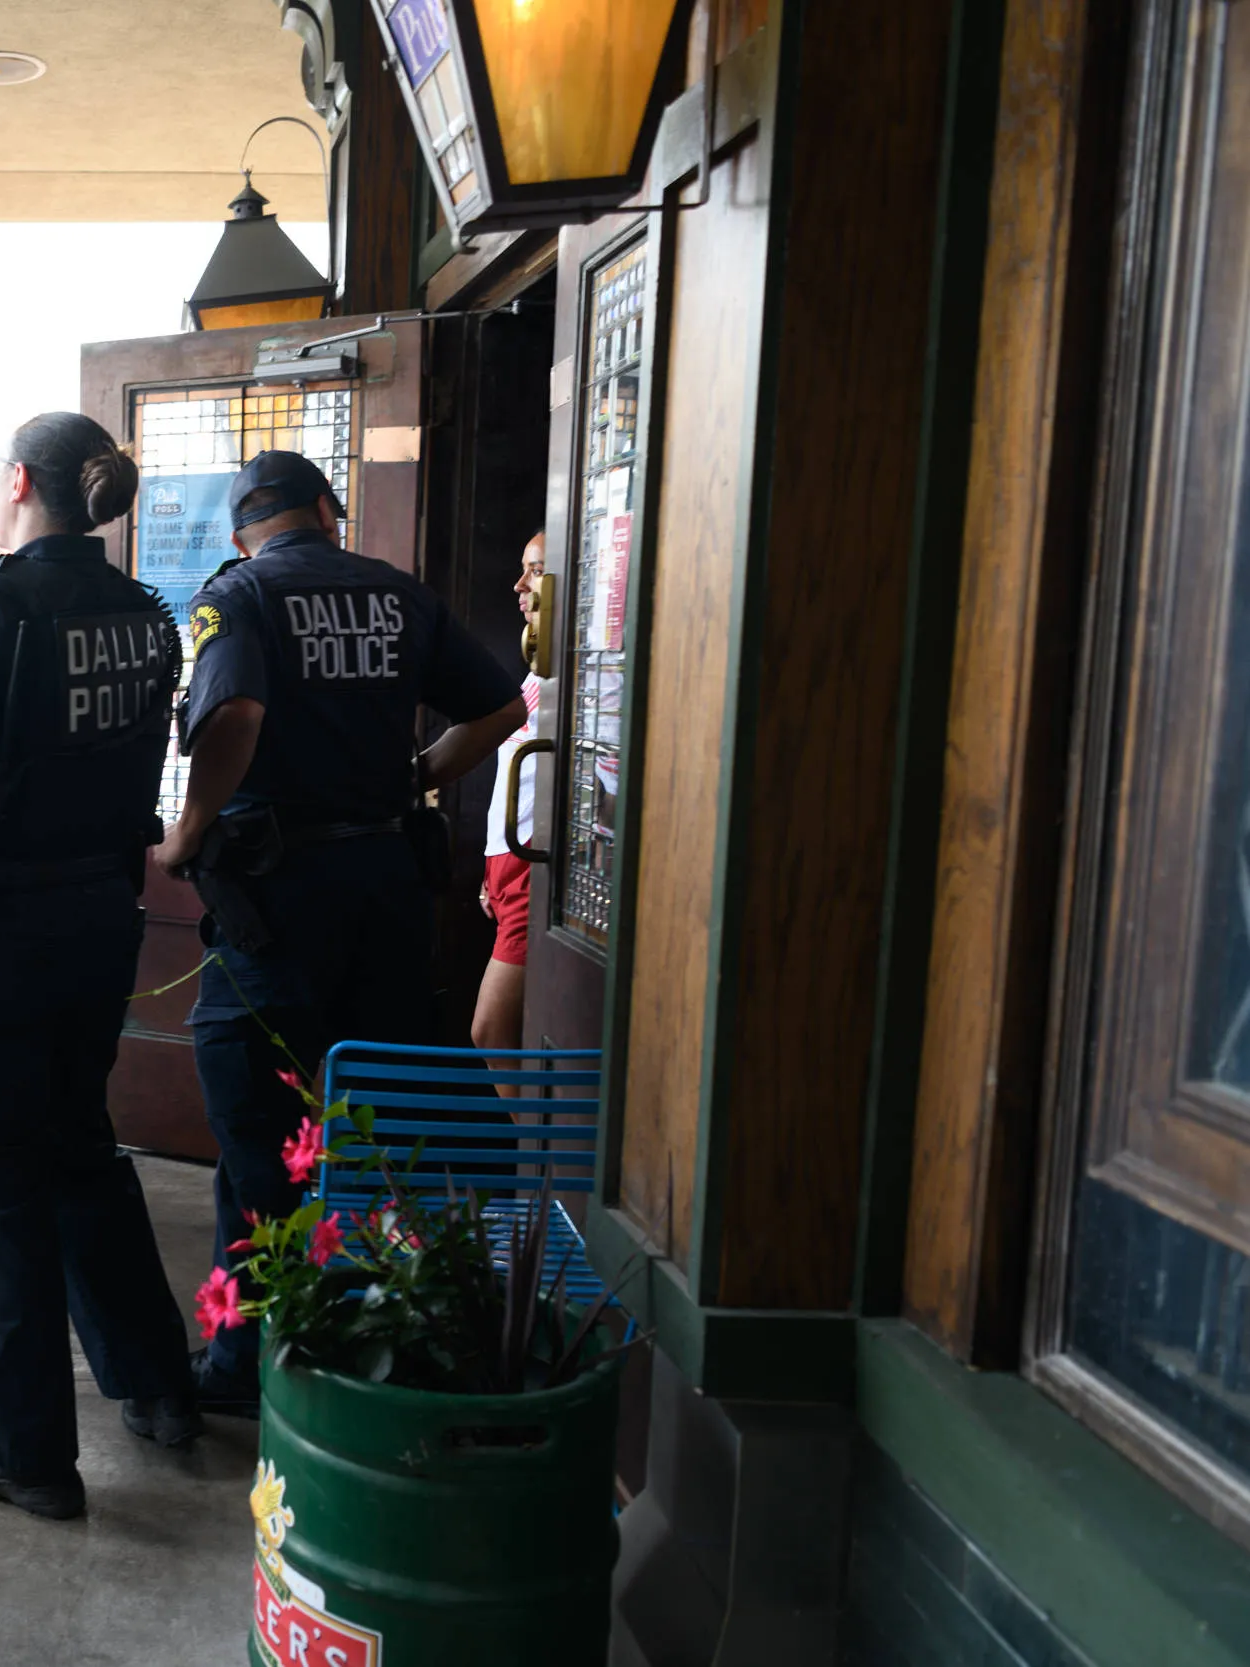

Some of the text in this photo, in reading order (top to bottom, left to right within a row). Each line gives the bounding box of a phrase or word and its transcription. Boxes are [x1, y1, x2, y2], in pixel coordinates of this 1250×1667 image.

[156, 522, 183, 534] GAME
[186, 521, 221, 534] WHERE
[191, 537, 223, 550] SENSE
[147, 553, 156, 567] IS
[284, 593, 404, 635] DALLAS
[301, 635, 399, 679] POLICE
